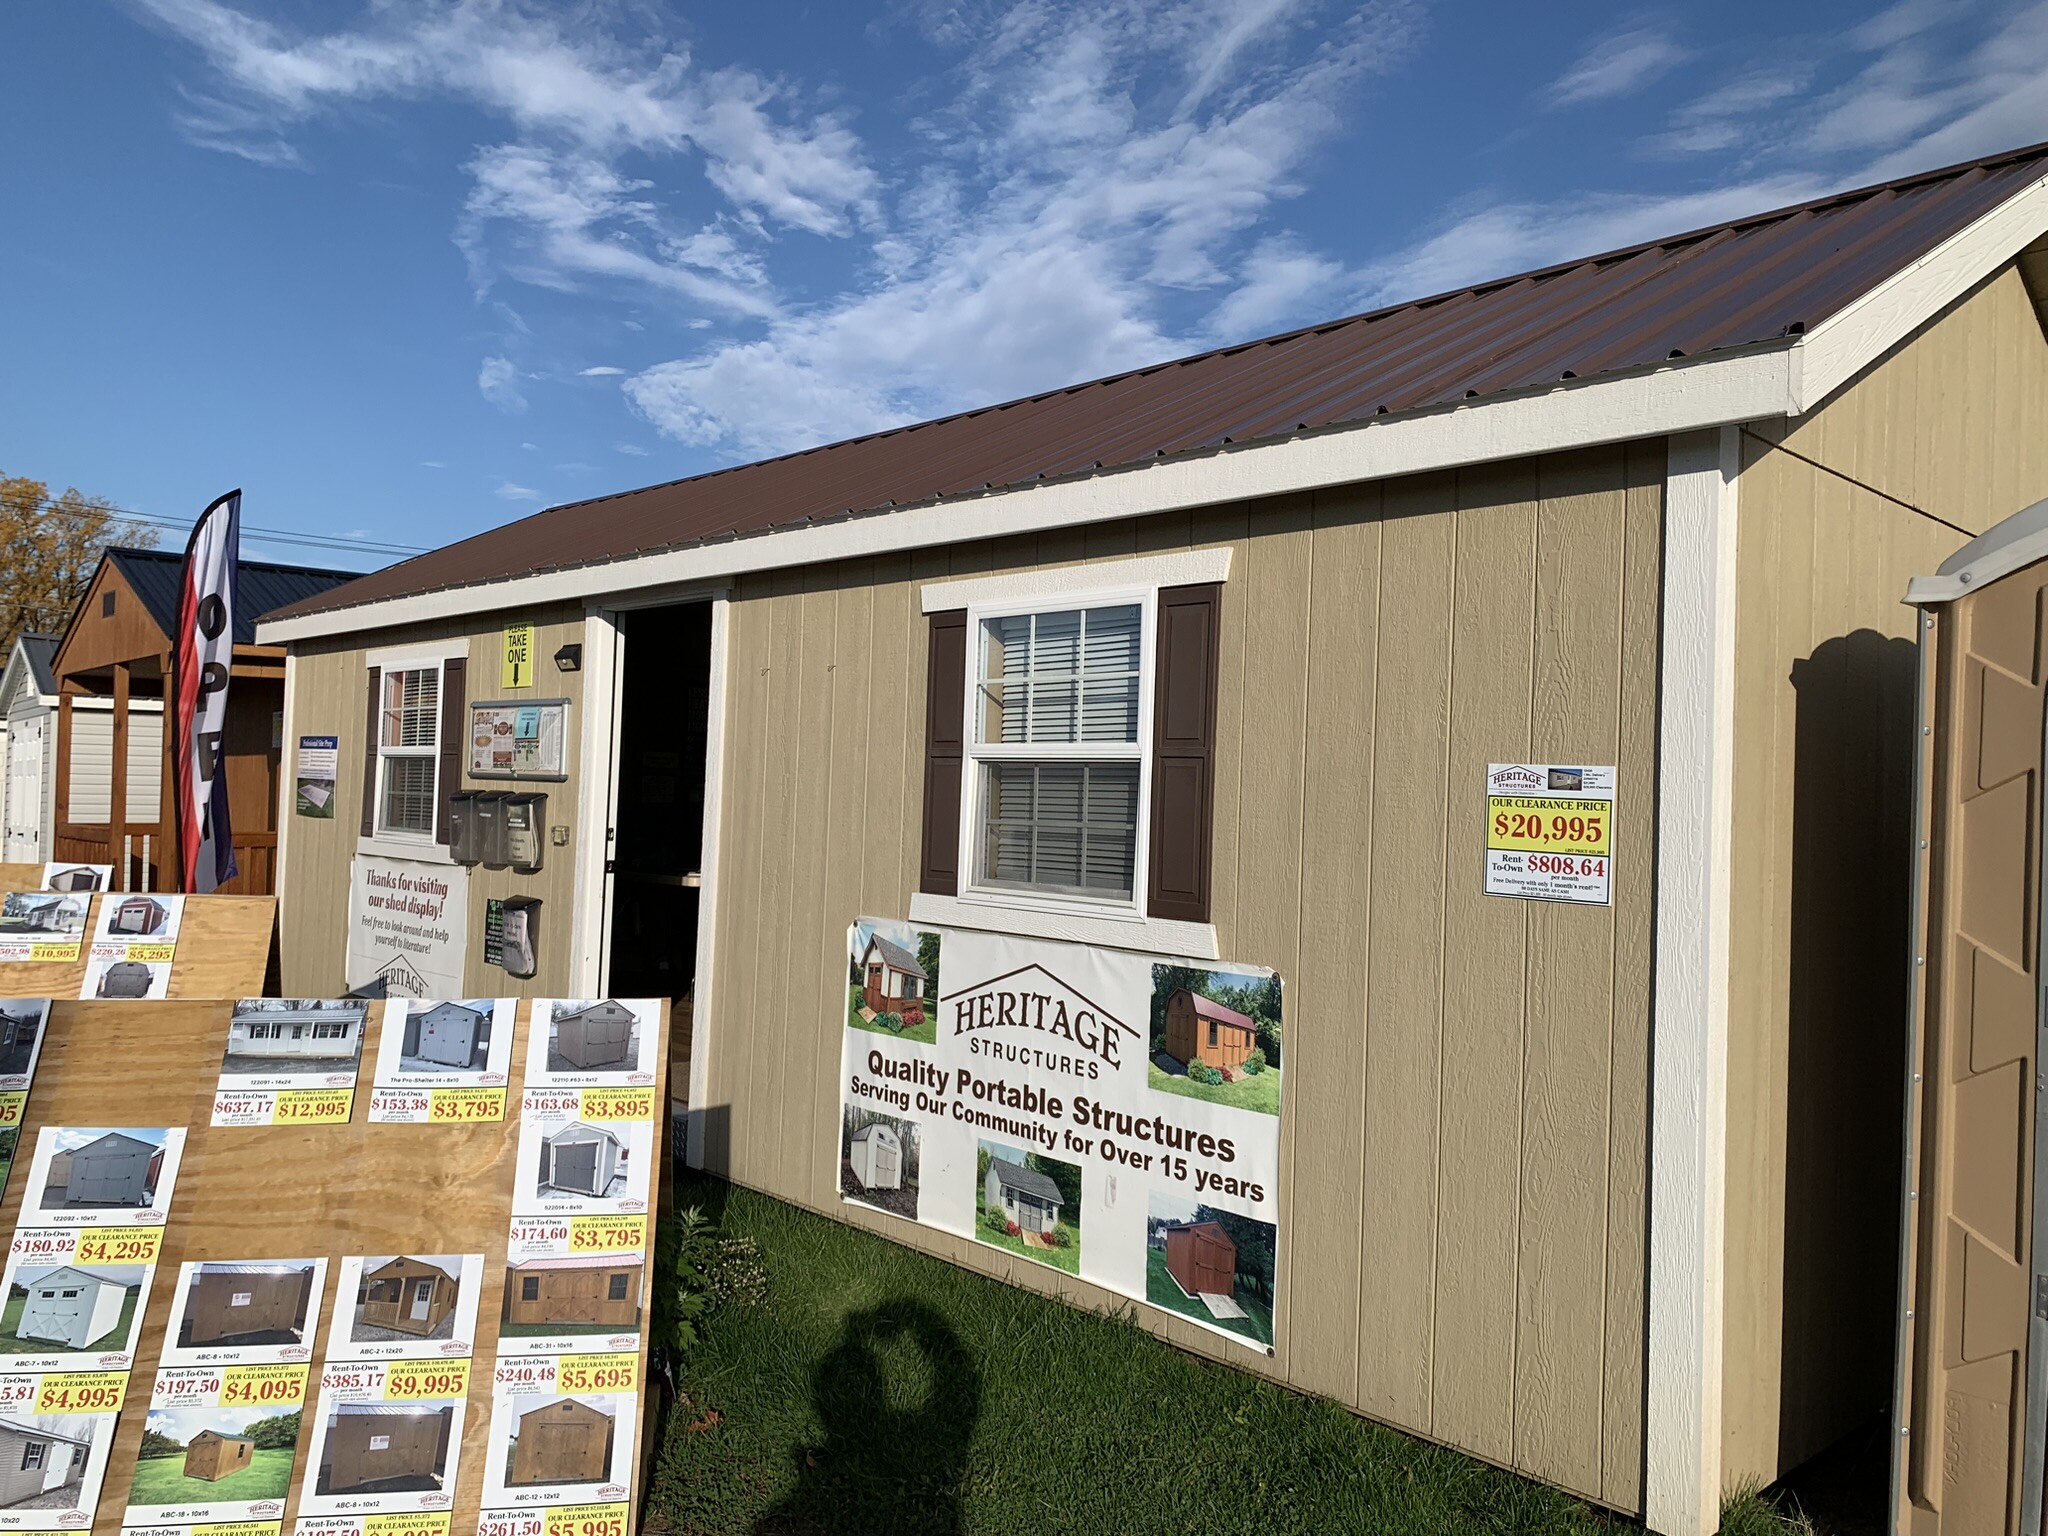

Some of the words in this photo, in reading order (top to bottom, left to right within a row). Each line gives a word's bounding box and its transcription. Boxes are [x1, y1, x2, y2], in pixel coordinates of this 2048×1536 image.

[508, 624, 528, 634] PLEASE
[508, 634, 527, 648] TAKE
[508, 648, 526, 664] ONE
[1493, 772, 1541, 786] HERITAGE
[1492, 798, 1512, 808] OUR
[1515, 799, 1573, 810] CLEARANCE
[1577, 802, 1607, 811] PRICE
[1495, 811, 1602, 844] $20,995
[1502, 855, 1523, 863] Rent-
[1528, 854, 1604, 877] $808.64
[1492, 863, 1523, 872] To-Own
[367, 869, 396, 889] Thanks
[398, 873, 412, 890] for
[414, 877, 448, 899] visiting
[369, 895, 384, 907] our
[385, 893, 407, 912] shed
[408, 897, 443, 921] display!
[361, 915, 373, 926] Feel
[372, 917, 384, 930] free
[385, 920, 391, 930] to
[391, 920, 403, 933] look
[403, 925, 423, 937] around
[422, 928, 434, 938] and
[434, 928, 449, 944] help
[375, 935, 398, 950] yourself
[398, 938, 402, 948] to
[403, 938, 431, 954] literature!
[33, 950, 75, 958] $10,995
[129, 951, 170, 960] $5,295
[379, 968, 424, 998] HERITAGE
[954, 992, 1122, 1071] HERITAGE
[971, 1037, 1099, 1080] STRUCTURES
[215, 1101, 273, 1114] $637.17
[279, 1102, 345, 1118] $12,995
[372, 1098, 428, 1111] $153.38
[434, 1101, 499, 1120] $3,795
[525, 1098, 578, 1110] $163.68
[585, 1100, 649, 1119] $3,895
[868, 1050, 950, 1096] Quality
[957, 1068, 1063, 1119] Portable
[1073, 1096, 1236, 1163] Structures
[851, 1076, 910, 1112] Serving
[916, 1092, 947, 1117] Our
[952, 1102, 1058, 1150] Community
[1064, 1130, 1093, 1156] for
[1100, 1139, 1153, 1172] Over
[1161, 1154, 1187, 1182] 15
[1195, 1167, 1265, 1203] years
[511, 1227, 567, 1241] $174.60
[574, 1230, 641, 1249] $3,795
[13, 1239, 75, 1253] $180.92
[80, 1241, 155, 1263] $4,295
[322, 1374, 384, 1389] $385.17
[496, 1368, 555, 1383] $240.48
[562, 1368, 632, 1391] $5,695
[156, 1379, 219, 1395] $197.50
[225, 1380, 301, 1403] $4,095
[390, 1374, 463, 1398] $9,995
[41, 1388, 119, 1411] $4,995
[250, 1504, 280, 1512] HERITAGE
[488, 1512, 535, 1520] Rent-To-Own
[305, 1520, 354, 1528] Rent-To-Own
[479, 1521, 541, 1536] $261.50
[550, 1520, 621, 1536] $5995
